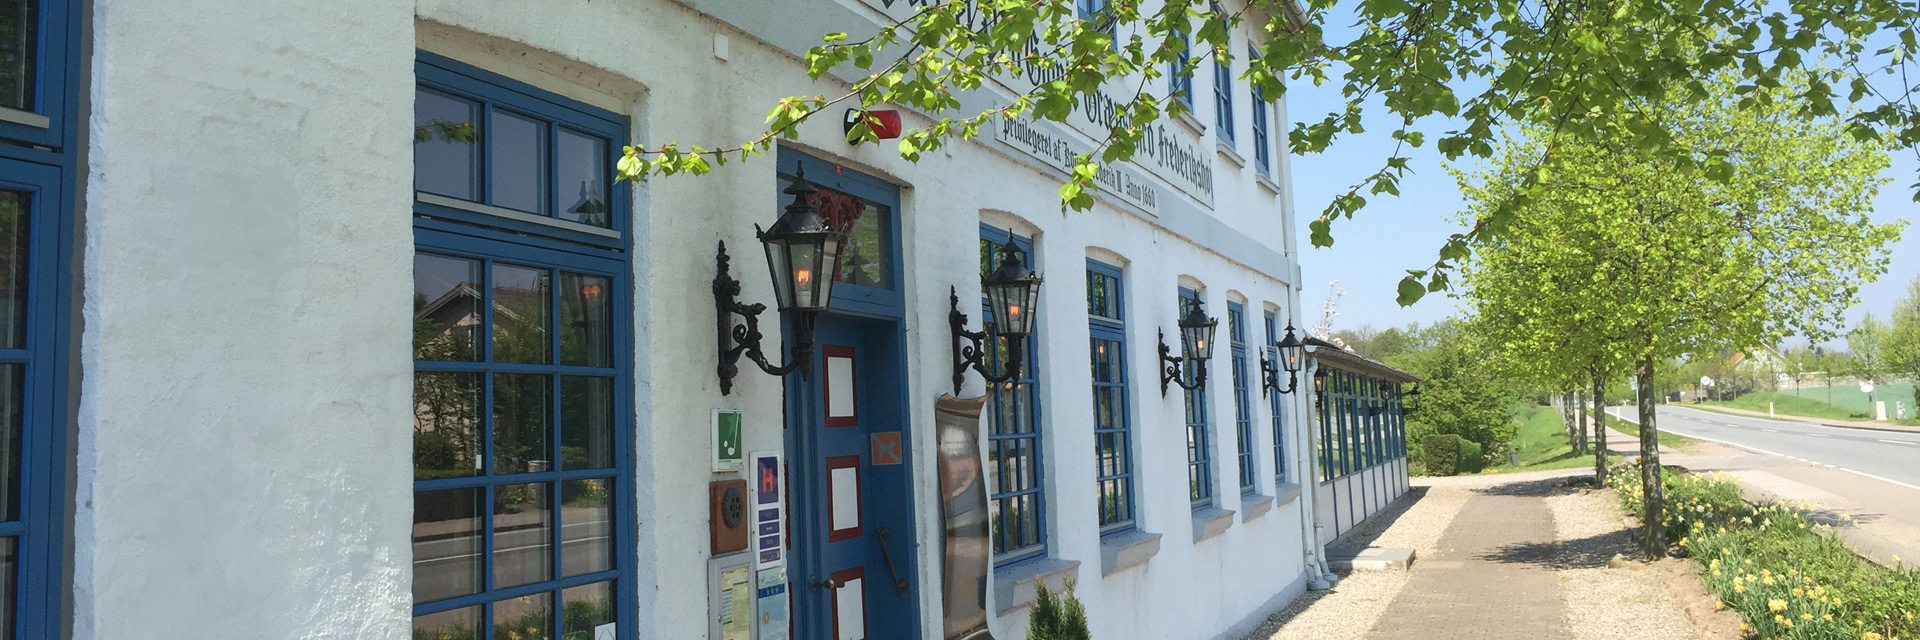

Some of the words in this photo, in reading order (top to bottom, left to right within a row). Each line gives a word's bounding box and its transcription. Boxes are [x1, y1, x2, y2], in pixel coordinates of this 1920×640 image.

[1054, 138, 1062, 163] af
[1125, 173, 1142, 202] Anno
[1142, 184, 1156, 209] 1660
